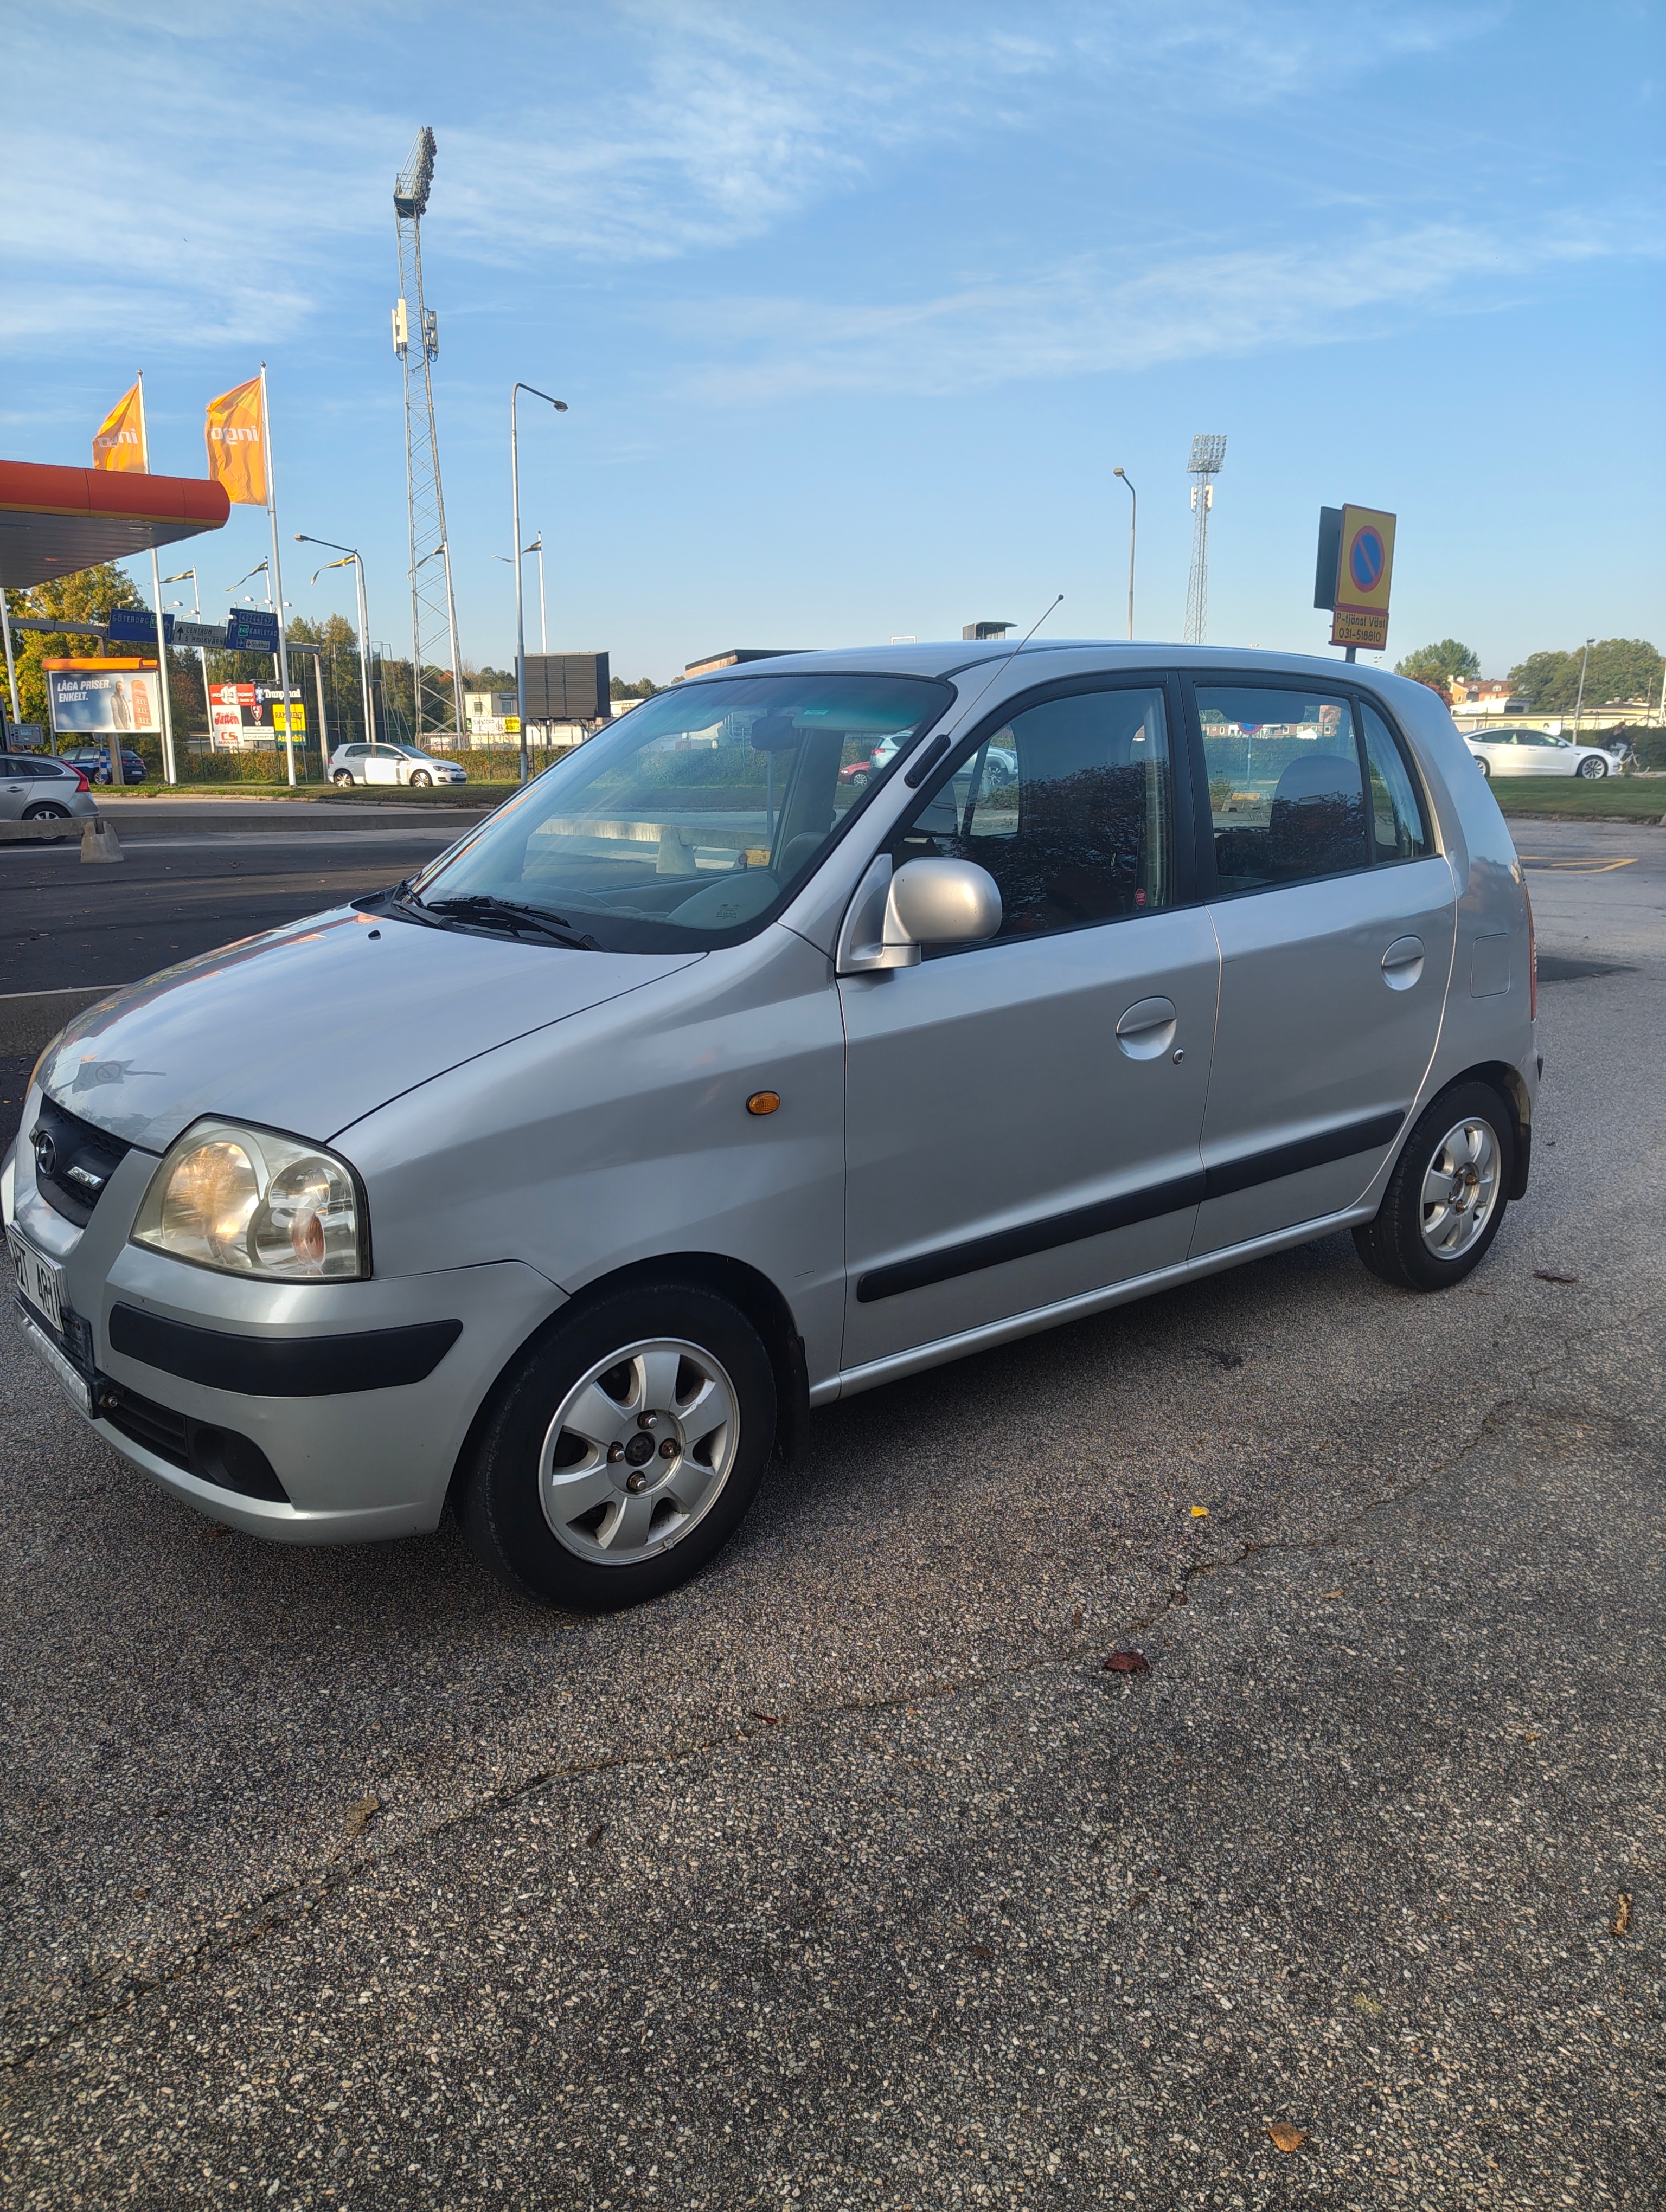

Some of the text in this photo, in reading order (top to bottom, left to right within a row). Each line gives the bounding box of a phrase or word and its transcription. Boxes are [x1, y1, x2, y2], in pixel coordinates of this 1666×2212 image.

[112, 614, 149, 625] GÖTEBORG
[1336, 613, 1385, 628] P-tjänst Väst
[186, 627, 212, 635] CENTRUM
[249, 628, 278, 636] KARLSTAD
[1339, 628, 1381, 642] 031-518810
[57, 680, 112, 692] LÅGA PRISER.
[59, 692, 88, 703] ENKELT.
[221, 732, 236, 741] CS
